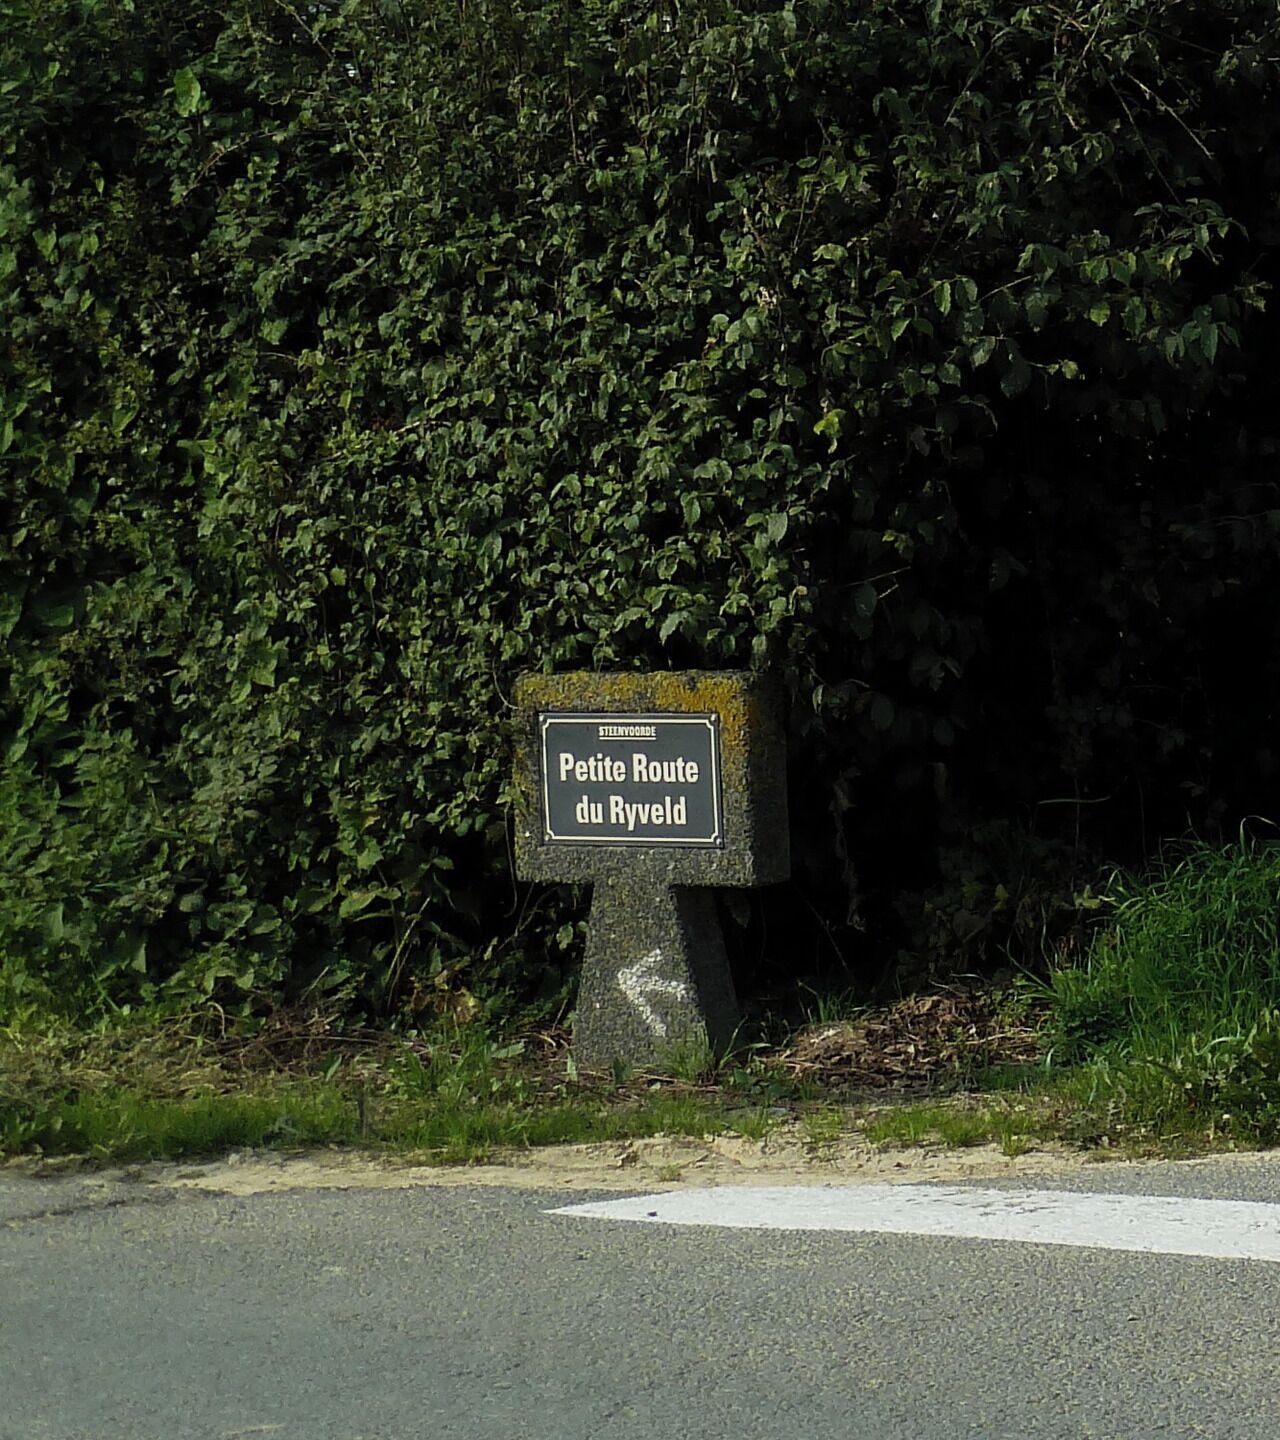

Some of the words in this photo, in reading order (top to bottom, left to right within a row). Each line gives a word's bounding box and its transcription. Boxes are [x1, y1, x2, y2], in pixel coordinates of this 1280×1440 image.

[598, 725, 657, 737] STEENVOORDE
[559, 752, 627, 782] Petite
[632, 753, 700, 783] Route
[575, 794, 604, 824] du
[609, 795, 687, 831] Ryveld
